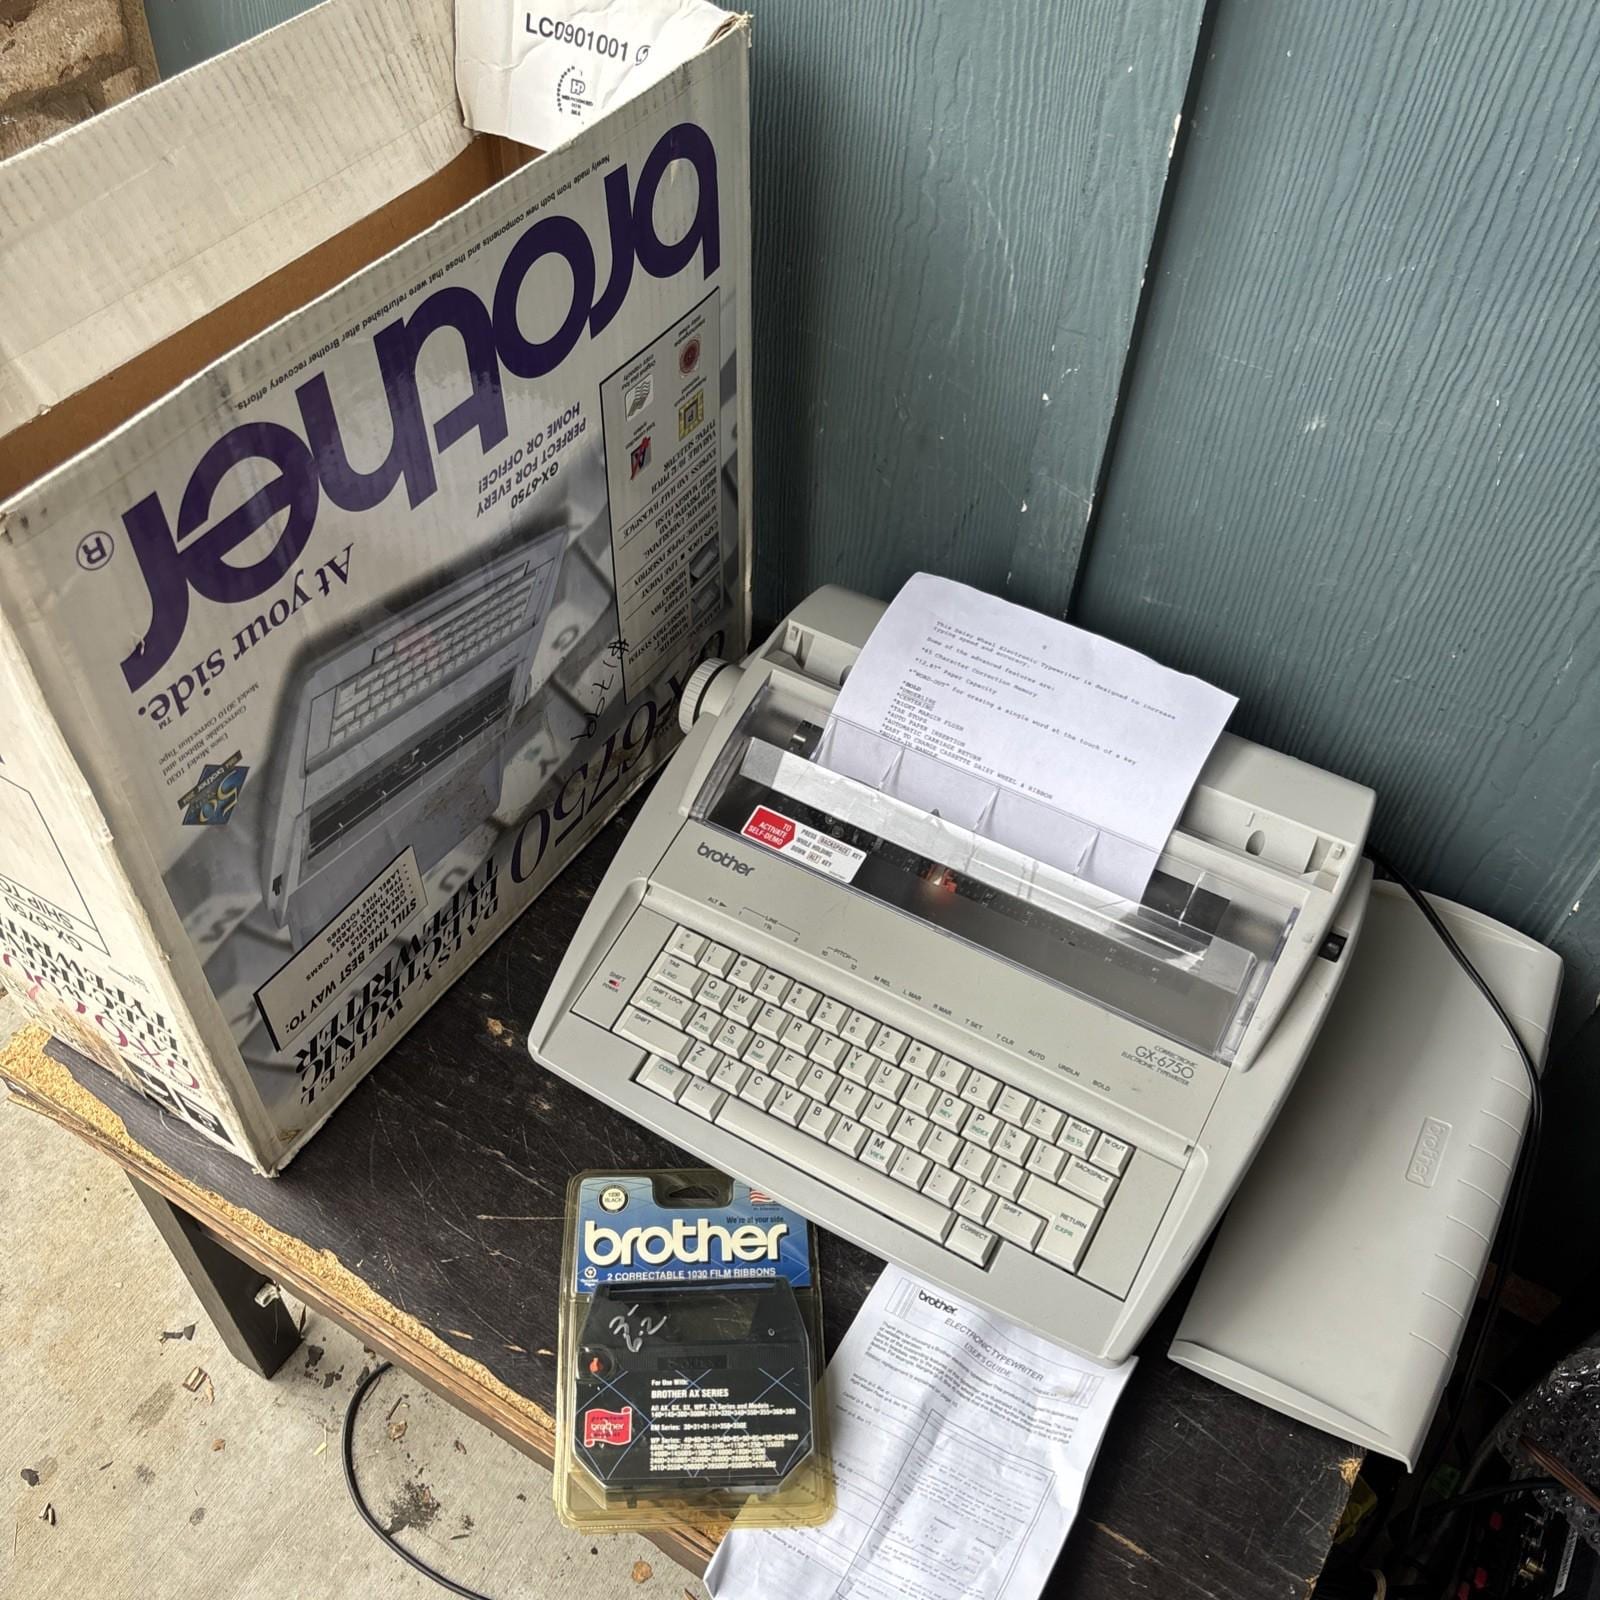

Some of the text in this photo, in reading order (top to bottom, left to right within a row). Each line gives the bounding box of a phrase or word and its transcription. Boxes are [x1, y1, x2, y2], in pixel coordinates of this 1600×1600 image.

[525, 12, 628, 61] LC0901001
[234, 154, 610, 410] Newly made from both new components and those that were refurbished after Brother recovery efforts.
[120, 122, 721, 694] brother
[547, 401, 580, 438] HOME
[526, 432, 544, 455] OR
[541, 417, 586, 464] PERFECT
[478, 449, 523, 494] OFFICE!
[510, 461, 559, 508] GX-6750
[515, 456, 538, 484] FOR
[476, 477, 512, 517] EVERY
[315, 543, 353, 596] At
[233, 569, 311, 660] your
[138, 649, 225, 728] side.
[158, 682, 259, 765] Model 3010 Correction Tape
[205, 705, 247, 741] Correctable
[178, 738, 205, 762] Ribbon
[210, 732, 228, 748] Uses
[162, 759, 177, 777] and
[186, 748, 210, 769] Model
[166, 767, 185, 785] 1030
[747, 825, 783, 845] SELF-DEMO
[759, 822, 787, 838] ACTIVATE
[782, 823, 792, 832] TO
[697, 842, 755, 877] brother
[801, 829, 817, 839] PRESS
[851, 852, 862, 860] KEY
[27, 897, 74, 930] SHIP
[326, 868, 400, 943] LABEL FILE FOLDERS
[330, 876, 402, 947] TYPE INDEX CARDS
[350, 889, 405, 946] CREATE LABELS
[5, 896, 83, 952] GX-6750
[305, 882, 404, 981] FILL IN MULTI-PART FORMS
[347, 896, 407, 957] TYPE ENVELOPES
[285, 897, 416, 1033] STILL THE BEST WAY TO:
[295, 850, 498, 1075] TYPEWRITER
[301, 871, 497, 1093] ELECTRONIC
[652, 985, 684, 1005] SHIFT LOCK
[301, 895, 498, 1104] DAISY WHEEL
[634, 1013, 652, 1025] SHIFT
[1027, 1049, 1046, 1061] AUTO
[1135, 1046, 1195, 1079] GX-6750
[1092, 1080, 1111, 1092] BOLD
[1071, 1122, 1092, 1136] RELOC
[1075, 1161, 1109, 1184] BACKSPACE
[726, 1216, 746, 1225] We're
[754, 1217, 768, 1225] your
[1002, 1203, 1022, 1218] SHIFT
[1059, 1212, 1087, 1230] RETURN
[584, 1218, 789, 1266] brother
[960, 1223, 988, 1241] CORRECT
[615, 1271, 684, 1280] CORRECTABLE
[687, 1270, 707, 1279] 1030
[710, 1269, 731, 1278] FILM
[733, 1267, 776, 1277] RIBBONS
[919, 1290, 957, 1315] brother
[944, 1318, 1044, 1382] ELECTRONIC TYPEWRITER
[985, 1359, 1010, 1378] GUIDE
[651, 1388, 729, 1399] BROTHER AX SERIES
